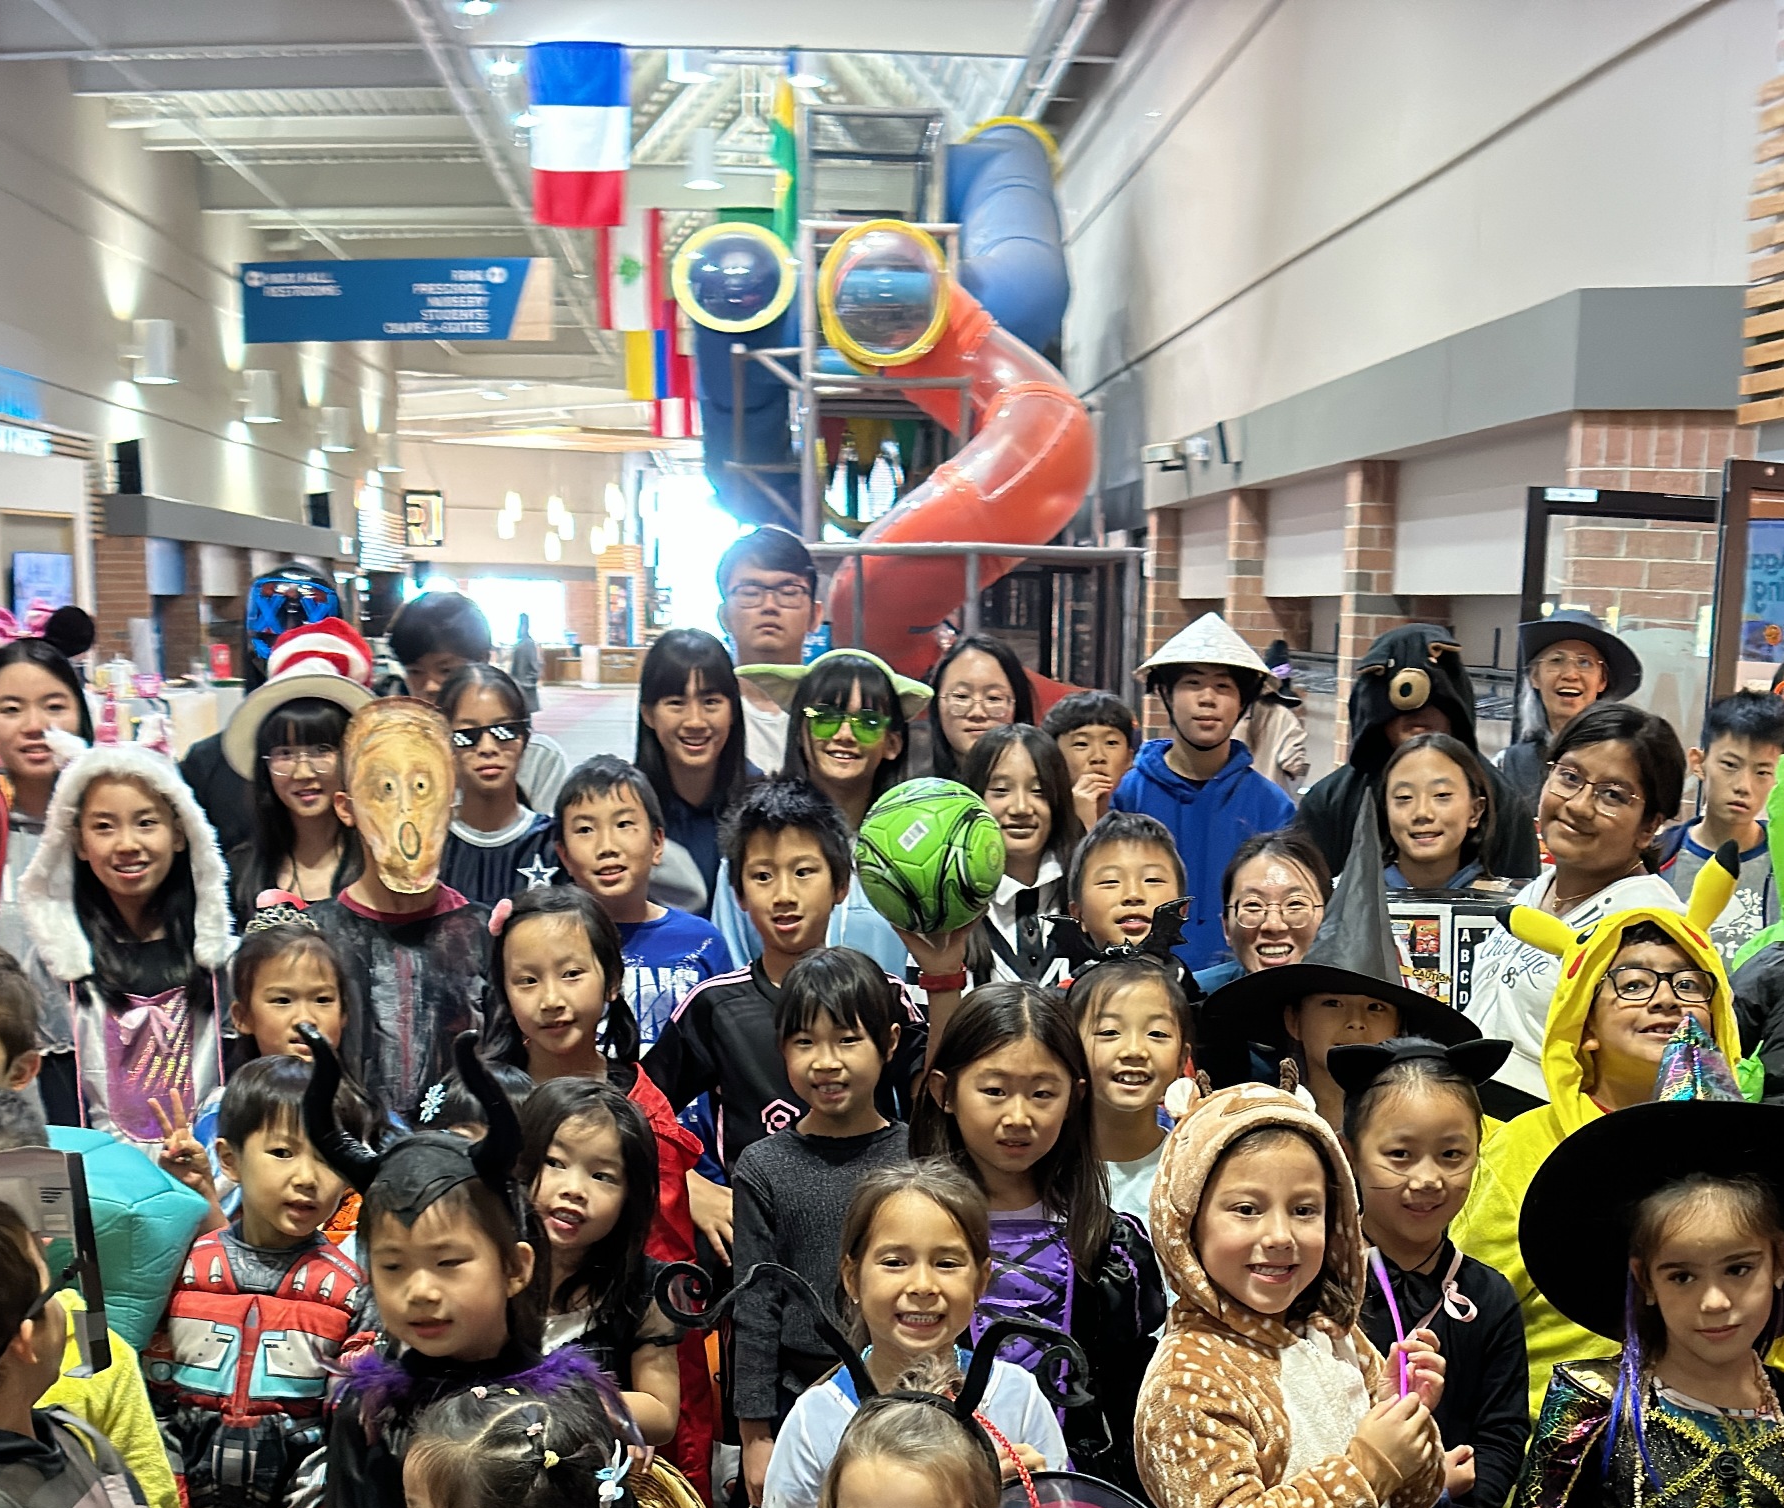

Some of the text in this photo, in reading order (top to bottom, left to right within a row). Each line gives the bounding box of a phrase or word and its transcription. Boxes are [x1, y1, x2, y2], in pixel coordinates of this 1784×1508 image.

[1460, 928, 1471, 942] A
[1460, 949, 1471, 963] B
[1411, 968, 1453, 985] CAUTION
[1460, 970, 1471, 985] C
[1459, 990, 1470, 1005] D
